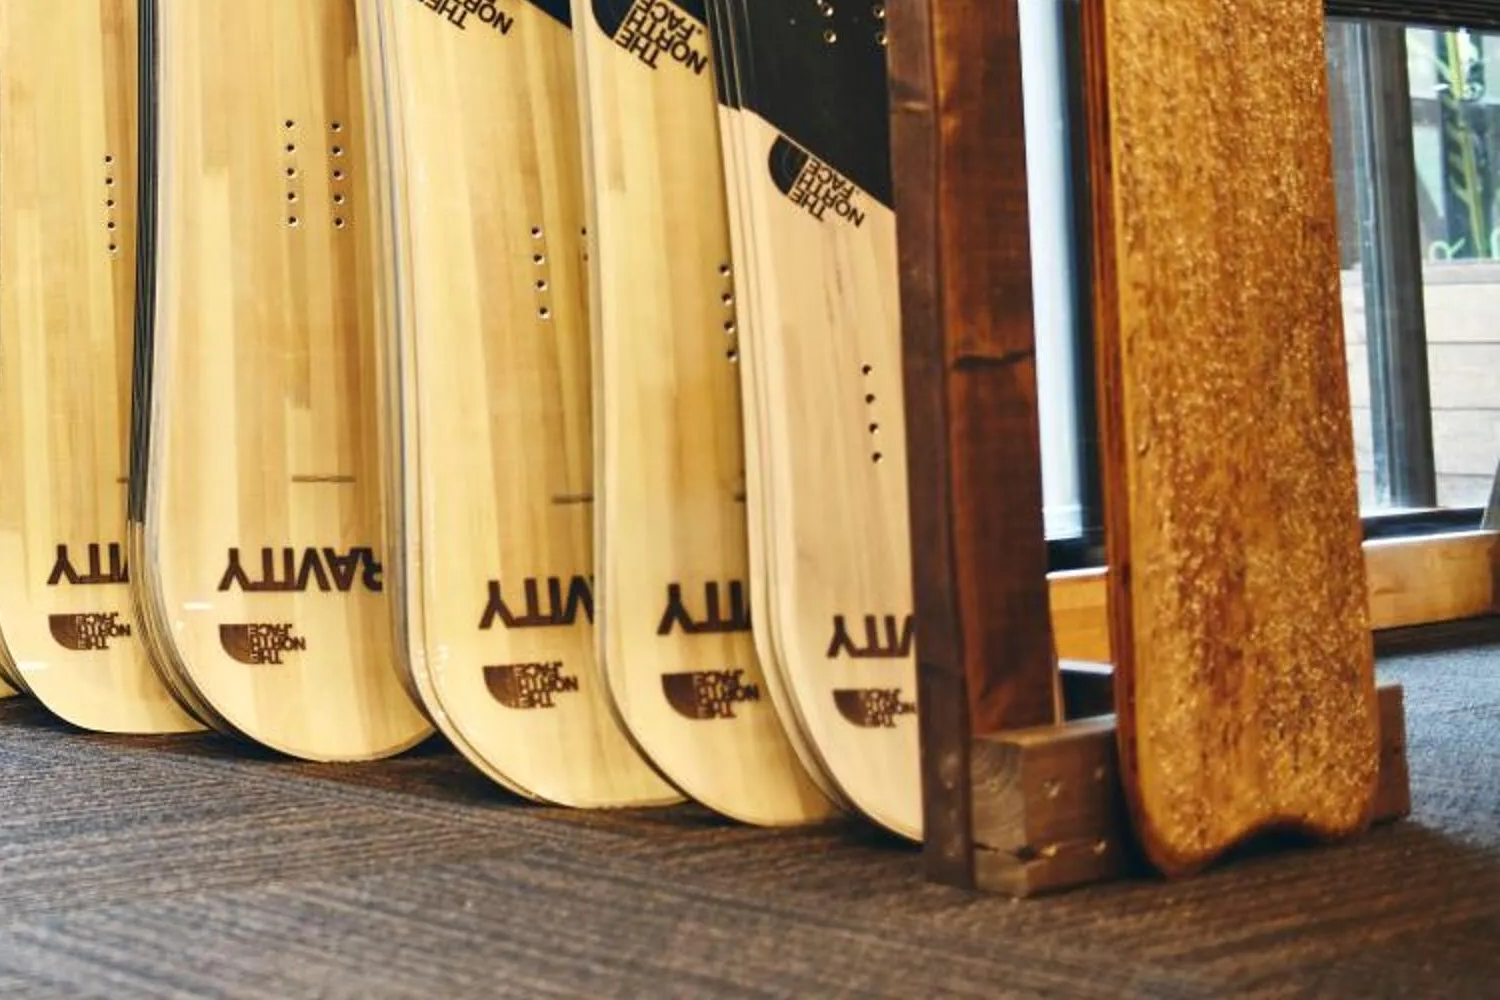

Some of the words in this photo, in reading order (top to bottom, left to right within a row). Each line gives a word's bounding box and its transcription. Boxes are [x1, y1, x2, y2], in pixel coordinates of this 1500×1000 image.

[615, 26, 659, 69] THE
[626, 10, 708, 75] NORTH
[799, 172, 865, 228] NORTH
[808, 158, 855, 199] FACE
[789, 189, 825, 222] THE
[479, 575, 594, 630] VITY
[657, 581, 751, 635] ITY
[250, 636, 307, 650] NORTH
[251, 649, 284, 665] THE
